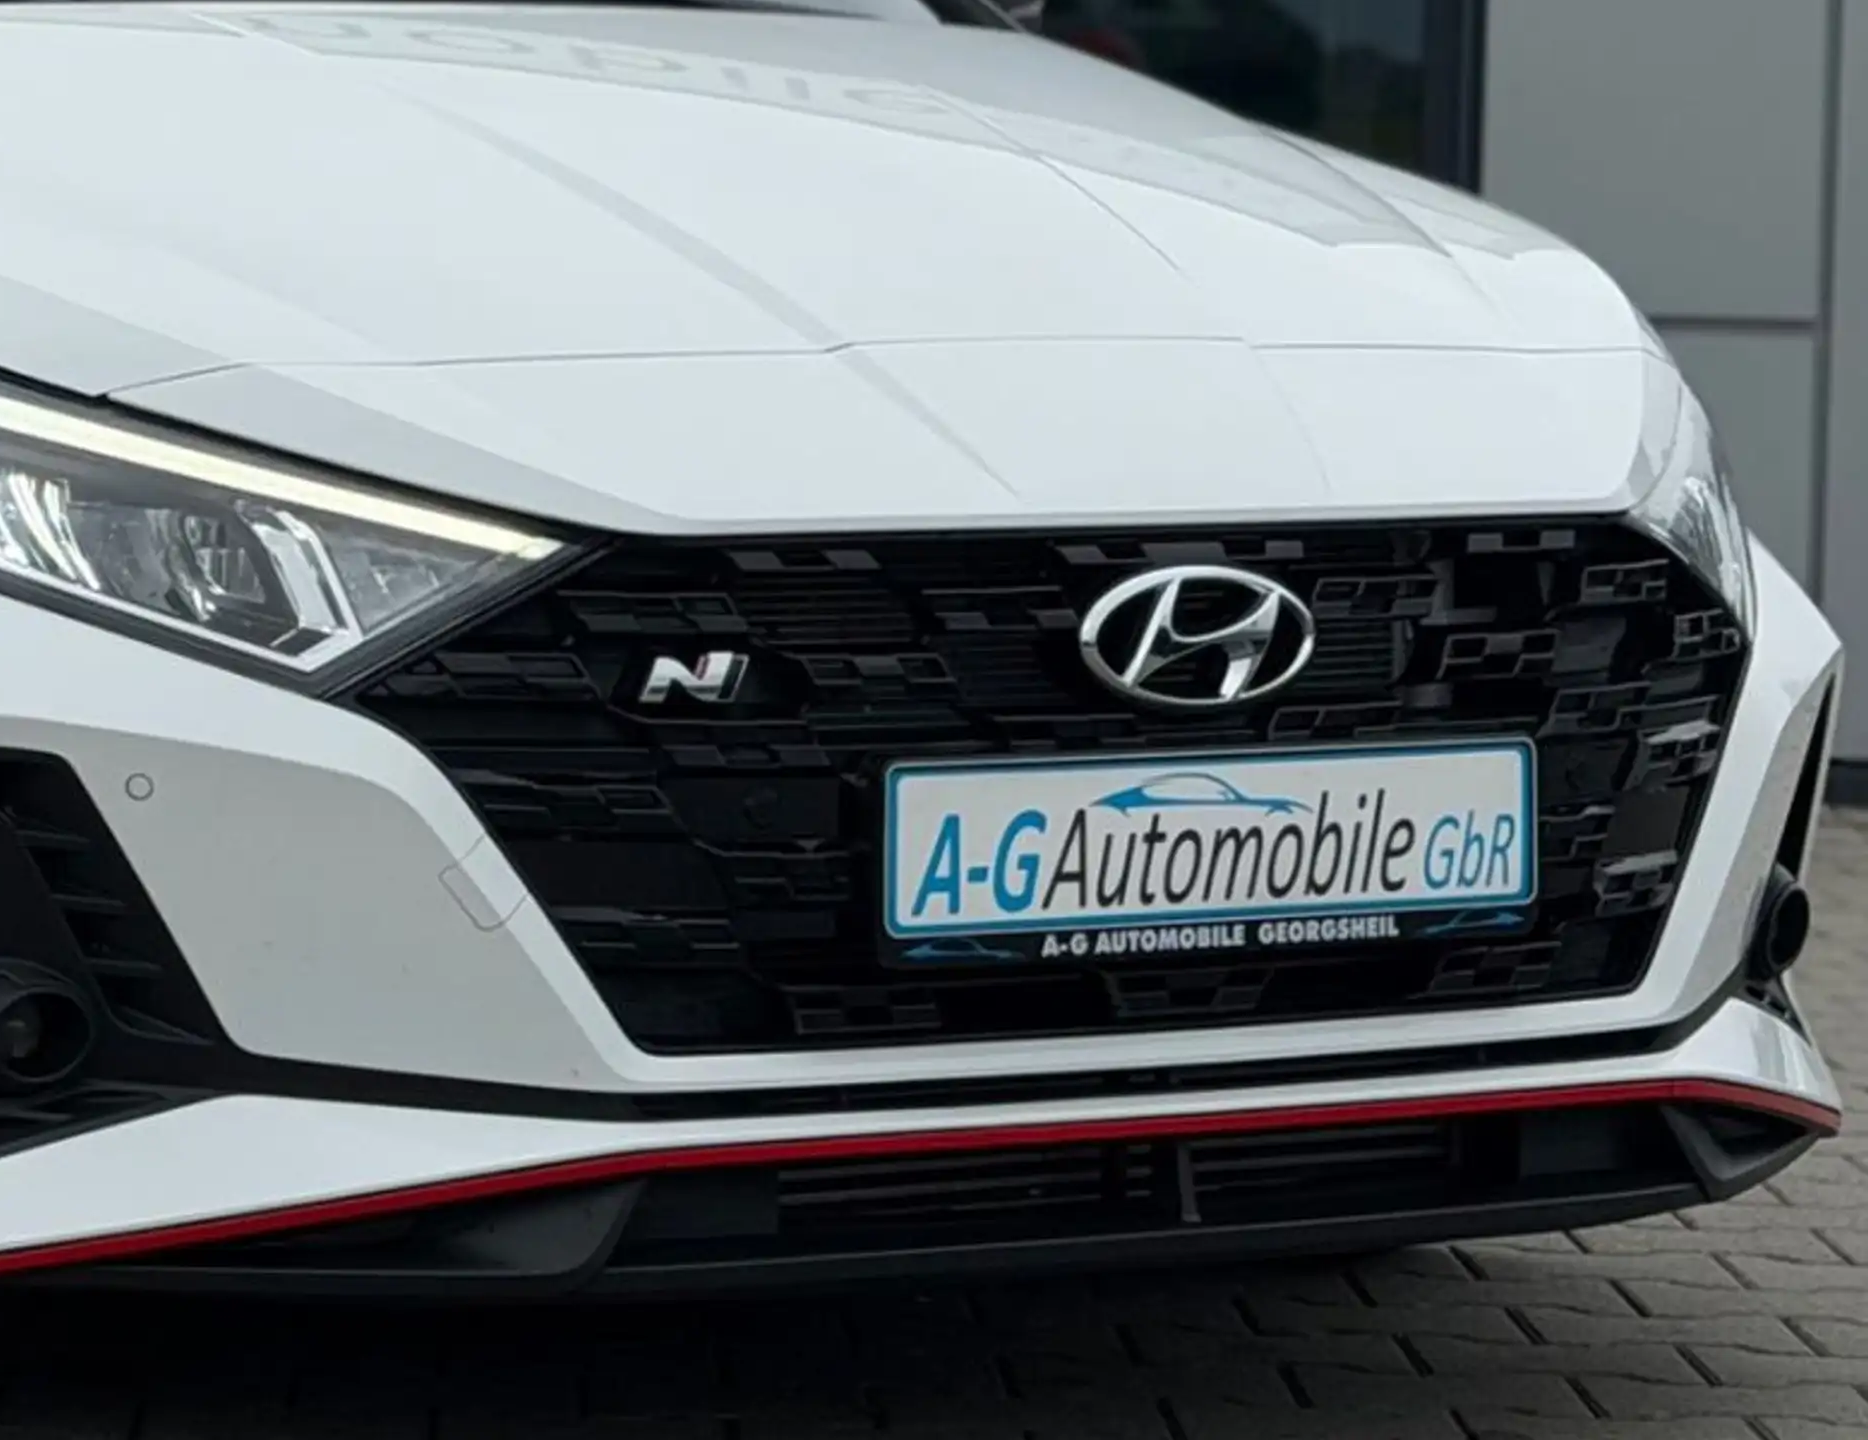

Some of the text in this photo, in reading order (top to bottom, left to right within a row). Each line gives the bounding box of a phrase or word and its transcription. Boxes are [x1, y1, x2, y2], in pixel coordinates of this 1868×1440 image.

[638, 650, 750, 703] N
[1422, 810, 1518, 892] GbR
[1040, 914, 1401, 958] A-G AUTOMOBILE GEORGSHEIL
